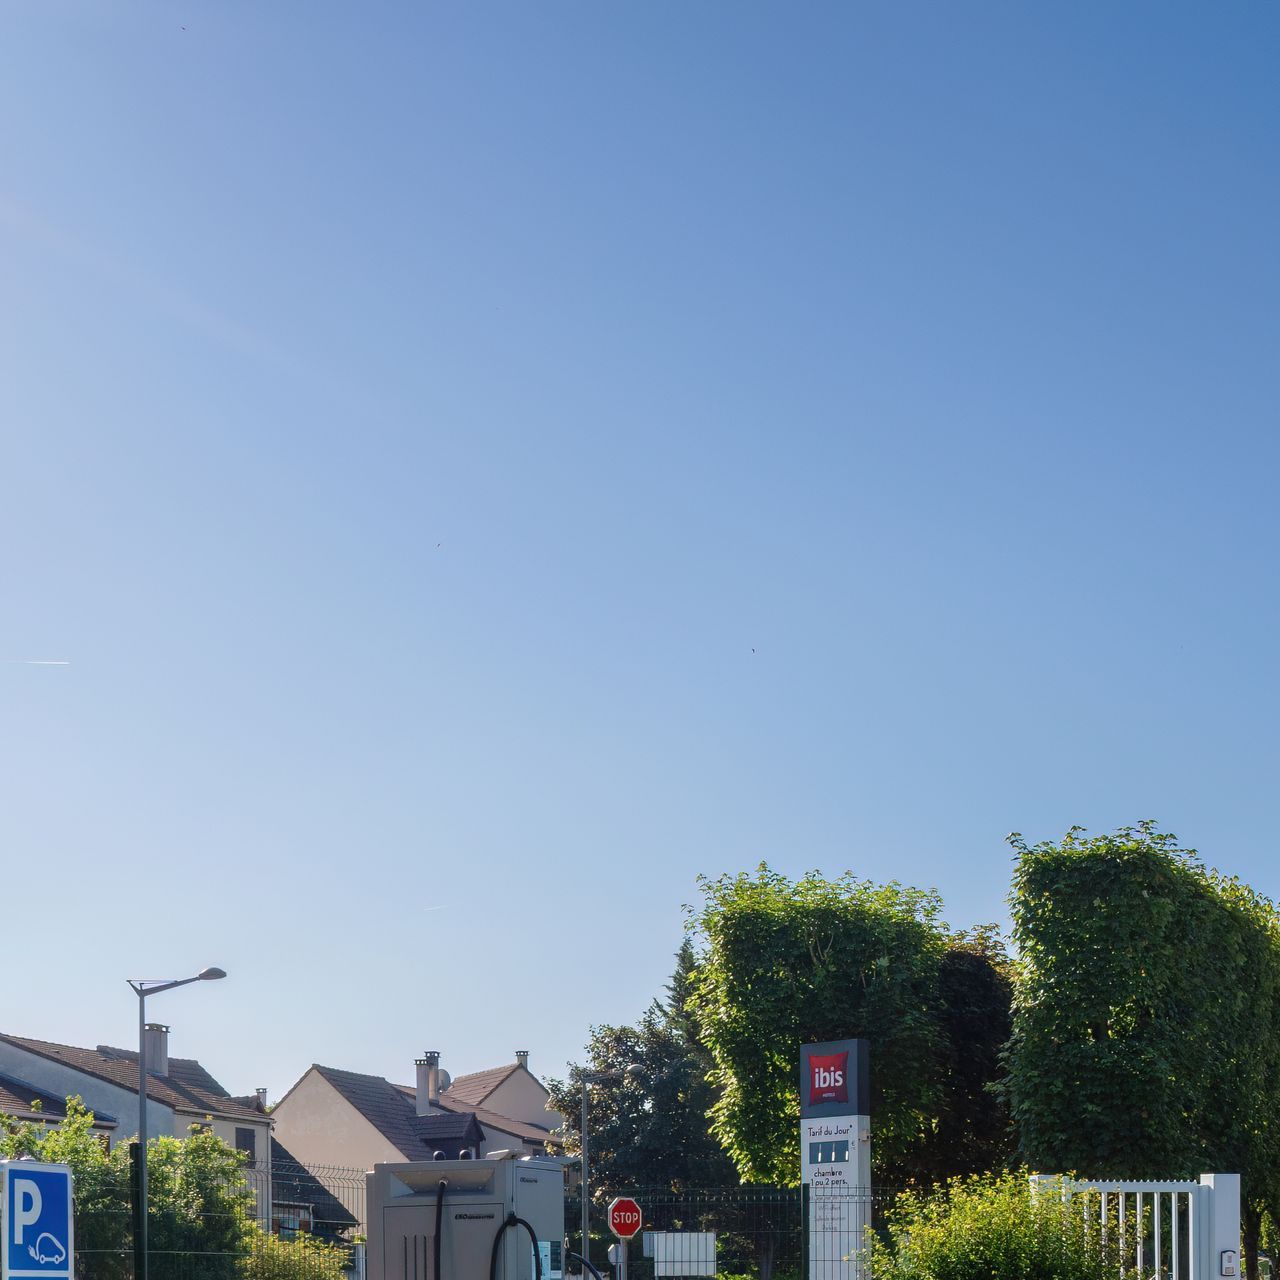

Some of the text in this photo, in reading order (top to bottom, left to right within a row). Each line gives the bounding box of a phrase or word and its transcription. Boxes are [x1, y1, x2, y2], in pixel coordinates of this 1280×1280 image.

[814, 1066, 843, 1088] ibis
[807, 1125, 823, 1137] Tarif
[823, 1125, 833, 1136] du
[813, 1166, 843, 1178] chambre
[825, 1178, 830, 1186] 2
[831, 1178, 848, 1187] pers.
[14, 1178, 43, 1245] P
[613, 1212, 639, 1224] STOP
